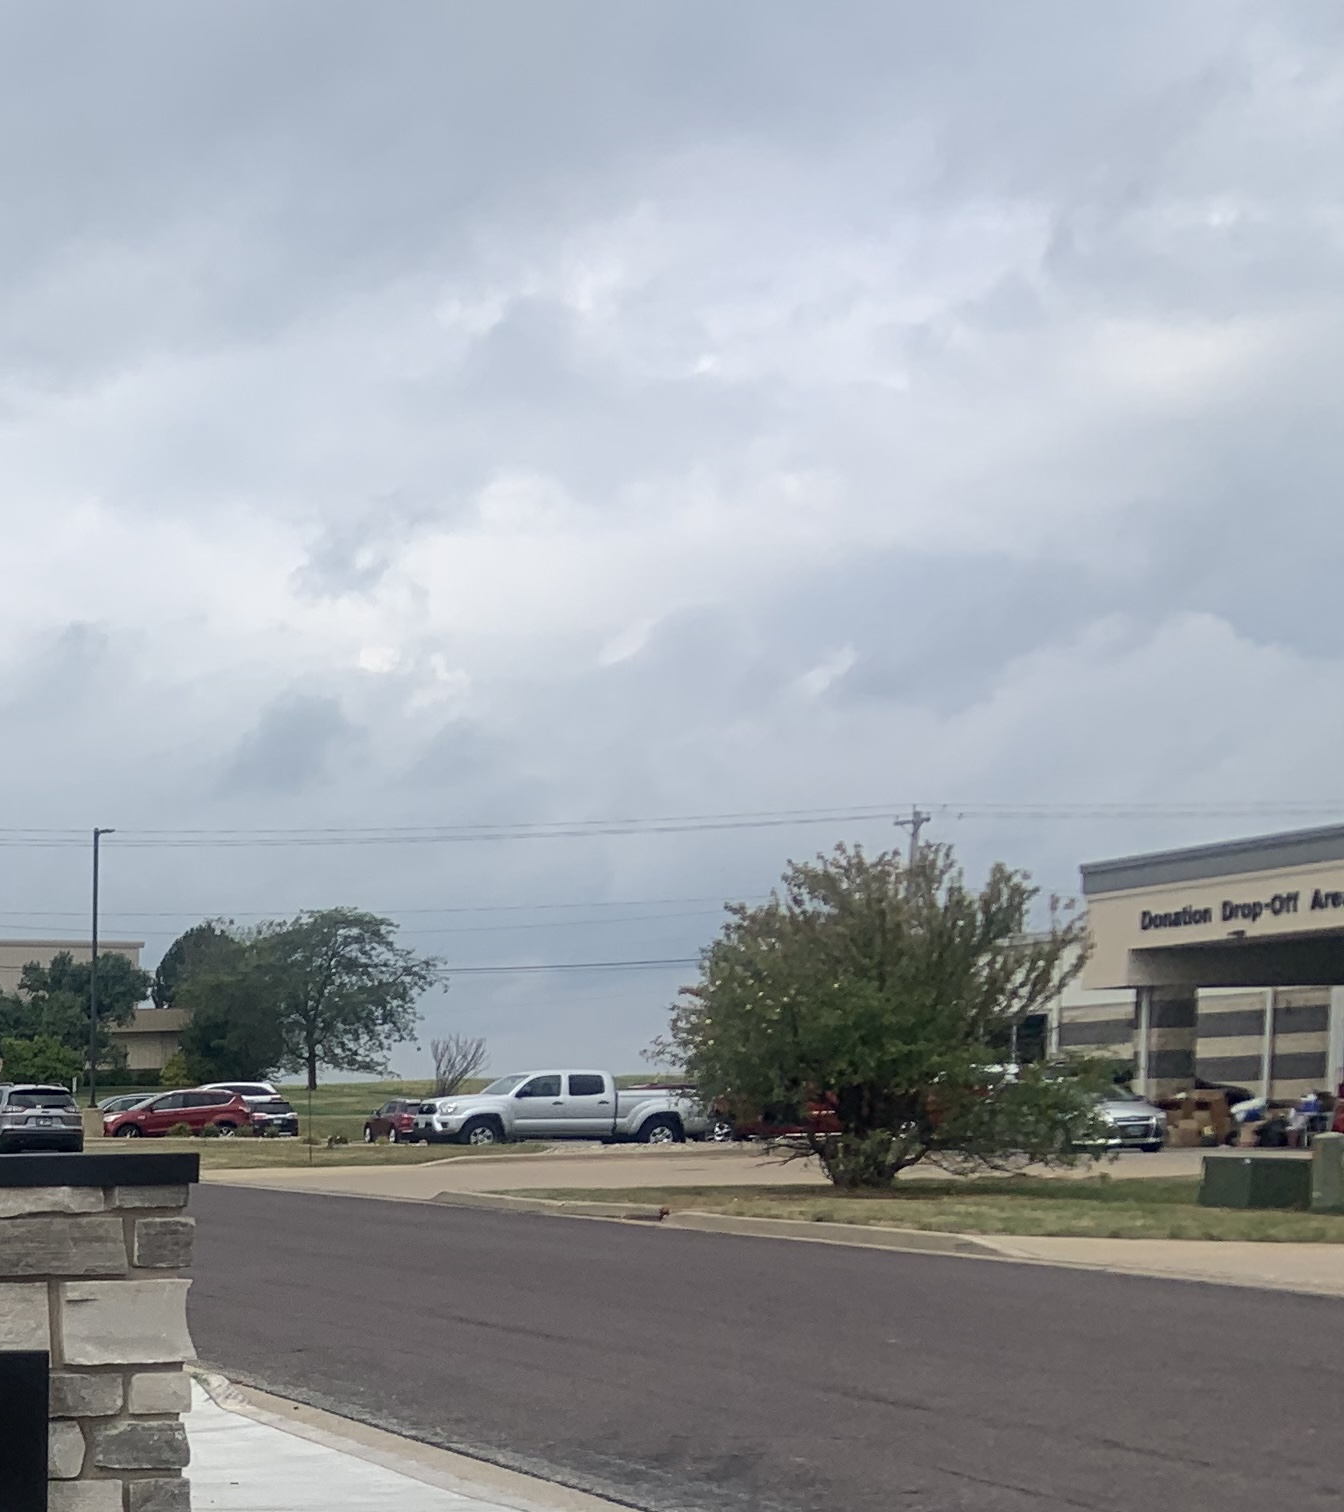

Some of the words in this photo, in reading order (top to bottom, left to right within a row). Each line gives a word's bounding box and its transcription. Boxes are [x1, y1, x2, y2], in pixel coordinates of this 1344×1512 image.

[1141, 905, 1212, 930] Donation
[1222, 891, 1299, 922] Drop-Off
[1311, 888, 1344, 910] Are
